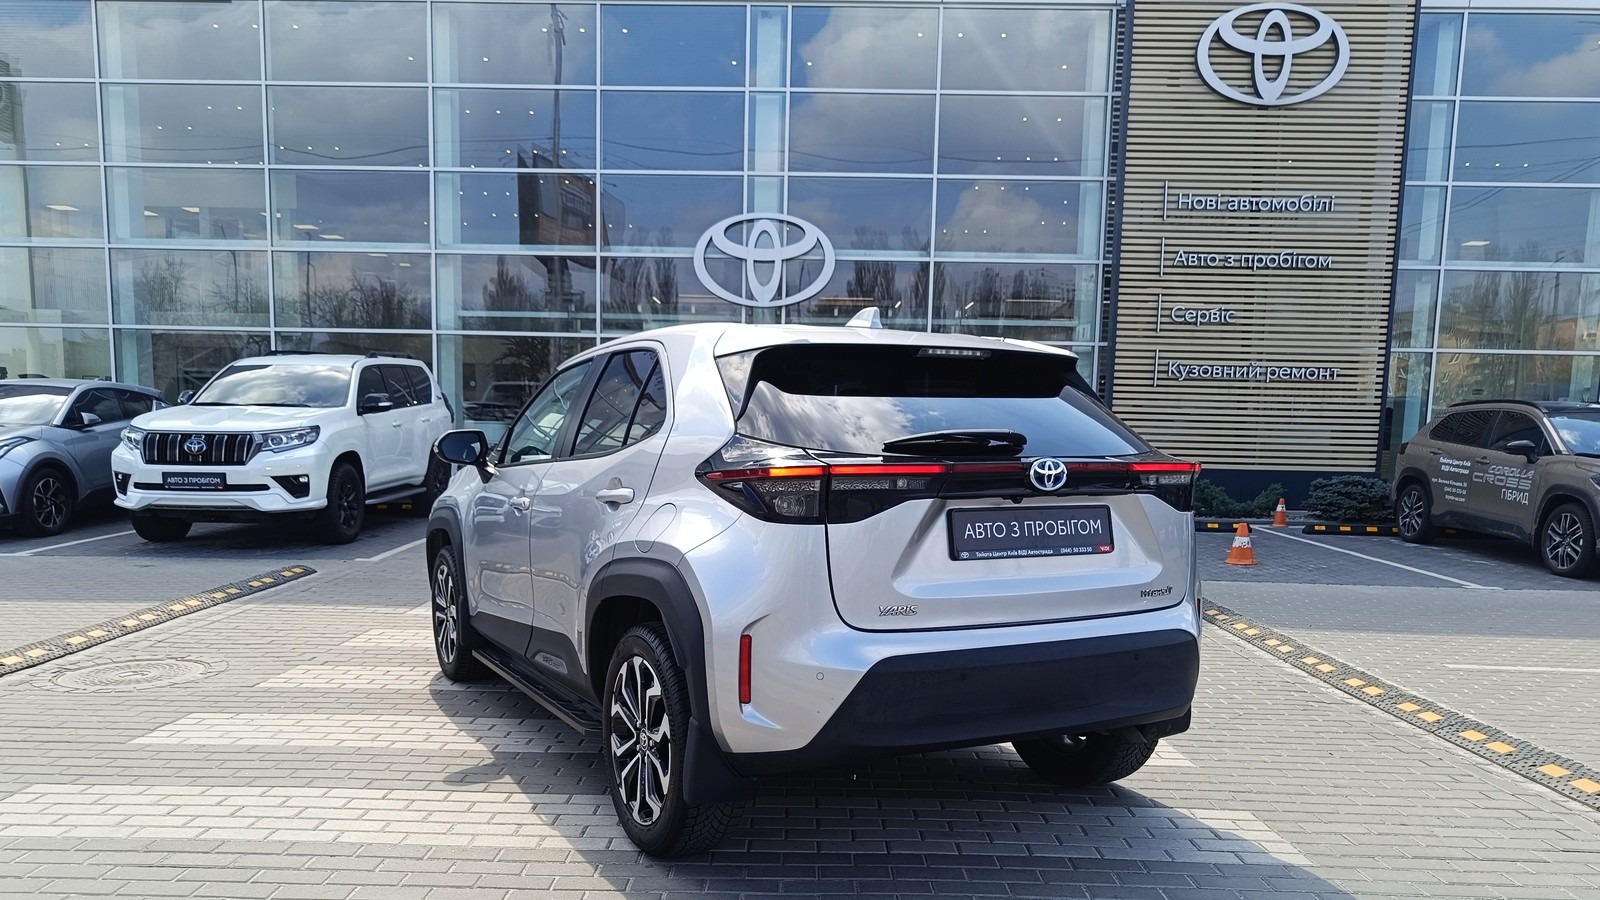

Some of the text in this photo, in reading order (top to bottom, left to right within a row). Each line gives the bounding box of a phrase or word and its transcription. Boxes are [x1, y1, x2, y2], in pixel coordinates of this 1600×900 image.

[1177, 192, 1336, 212] Нові автомобілі
[1173, 249, 1333, 272] Авто з пробігом
[1170, 305, 1237, 327] Сервіс
[1167, 360, 1341, 383] Кузовний ремонт
[167, 476, 183, 484] АВТО
[1472, 471, 1532, 490] CROSS
[1488, 465, 1535, 479] COROLLA
[1501, 488, 1529, 506] ГІБРИД
[964, 519, 1102, 539] АВТО З ПРОБІГОМ
[1027, 548, 1054, 556] Автострада
[879, 604, 919, 617] YARIS
